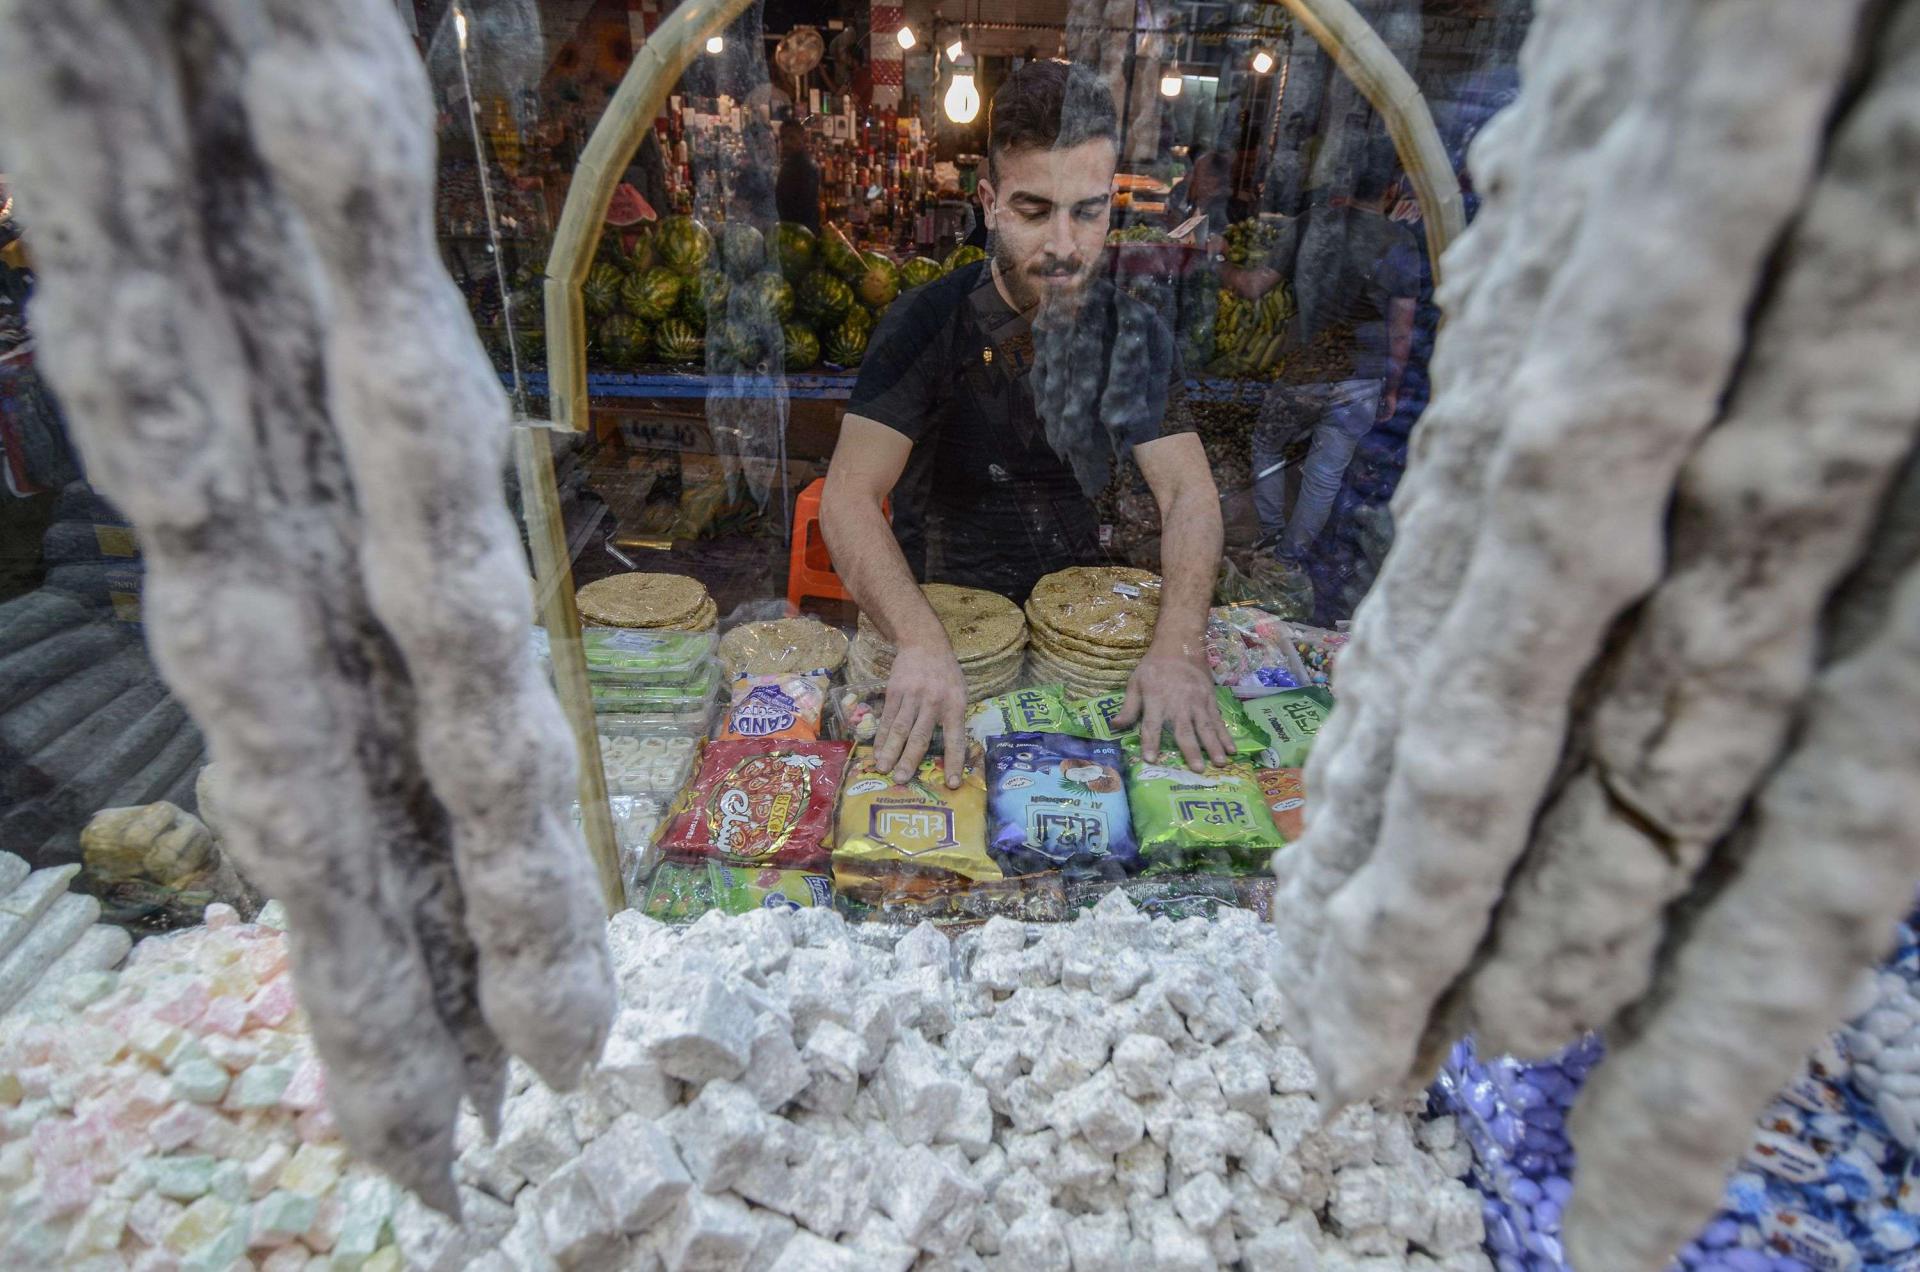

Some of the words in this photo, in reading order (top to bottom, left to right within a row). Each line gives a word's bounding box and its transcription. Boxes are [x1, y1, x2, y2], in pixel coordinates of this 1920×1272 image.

[728, 713, 792, 734] CANDY
[1178, 798, 1246, 825] الدباغ
[880, 812, 943, 839] الدباغ
[1035, 813, 1101, 847] الدباغ
